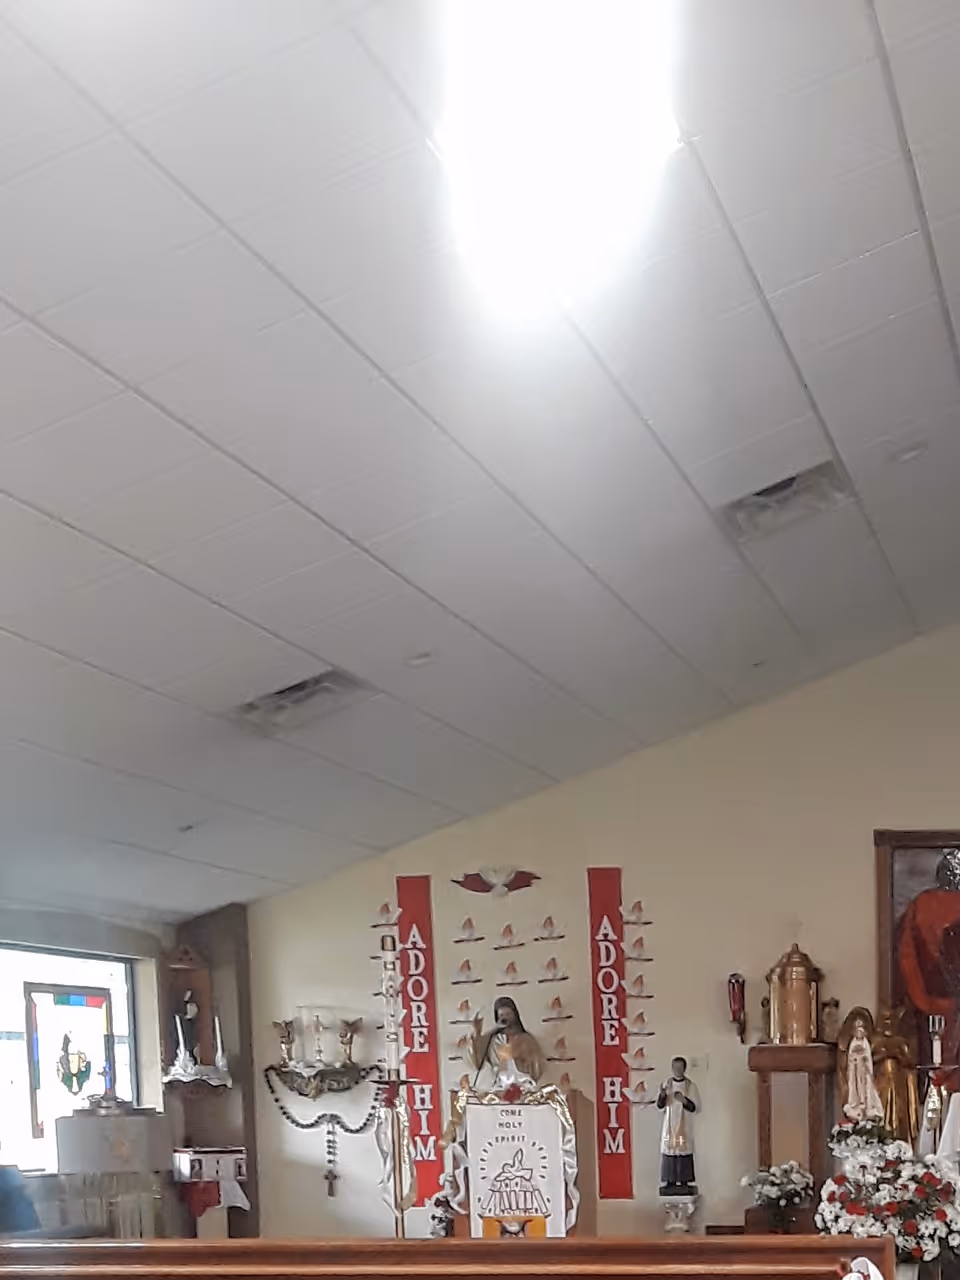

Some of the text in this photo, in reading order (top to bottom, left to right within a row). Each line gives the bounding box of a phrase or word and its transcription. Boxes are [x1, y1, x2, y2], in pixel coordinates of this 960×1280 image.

[595, 914, 626, 1154] ADORE HIM
[405, 923, 437, 1161] ADORE HIM
[500, 1109, 523, 1117] COME
[498, 1121, 523, 1129] HOLY
[495, 1135, 526, 1143] SPIRIT
